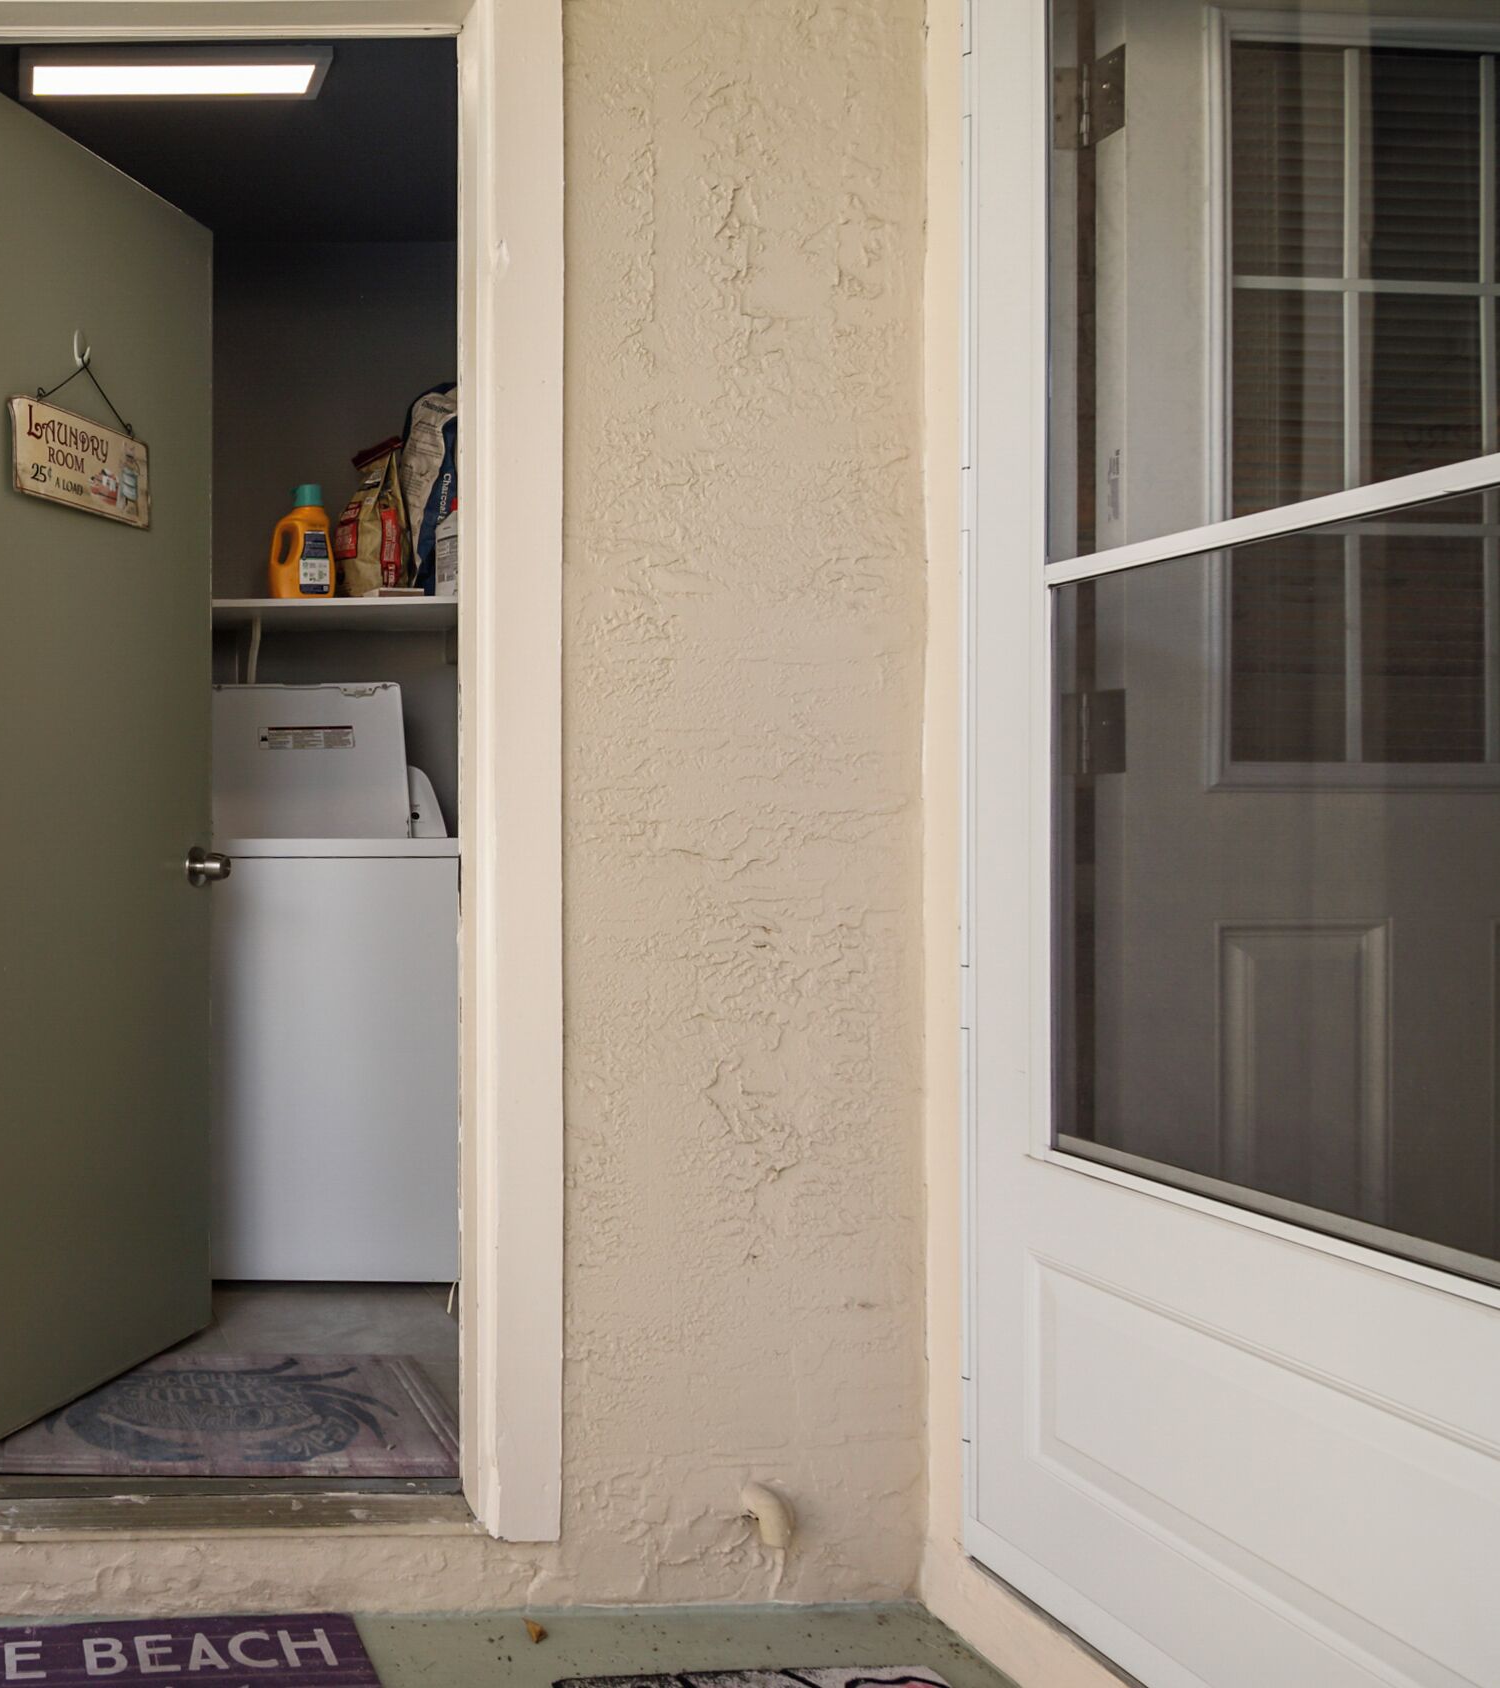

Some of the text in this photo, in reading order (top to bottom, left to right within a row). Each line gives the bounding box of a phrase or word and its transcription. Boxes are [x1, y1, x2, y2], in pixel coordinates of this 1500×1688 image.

[27, 404, 109, 463] LAUNDRY
[48, 446, 85, 474] ROOM
[55, 477, 60, 488] A
[440, 473, 452, 516] Charcoal
[82, 1628, 338, 1676] BEACH
